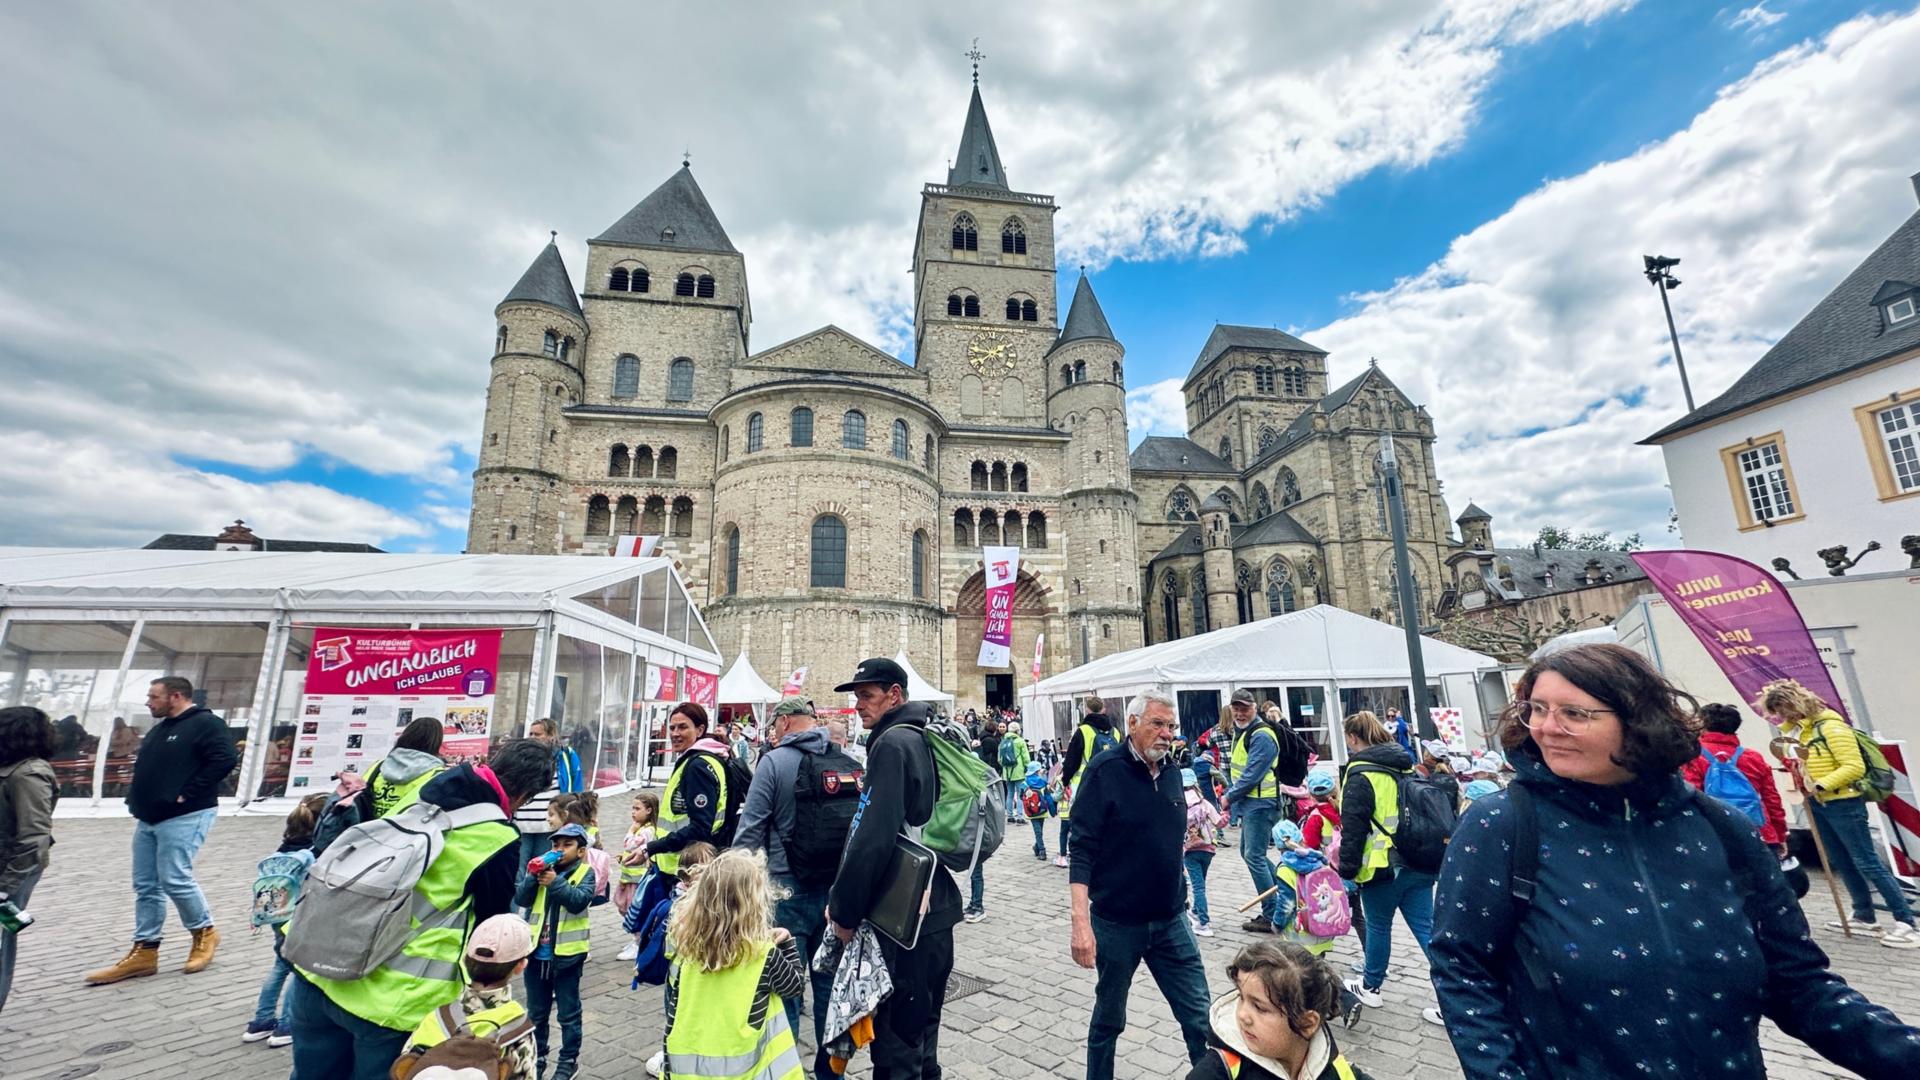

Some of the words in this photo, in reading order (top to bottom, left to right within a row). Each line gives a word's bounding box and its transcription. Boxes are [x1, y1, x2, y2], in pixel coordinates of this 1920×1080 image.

[992, 595, 1009, 609] UN
[356, 638, 412, 647] KULTURBÜHNE
[396, 677, 415, 690] ICH
[418, 665, 462, 684] GLAUBE
